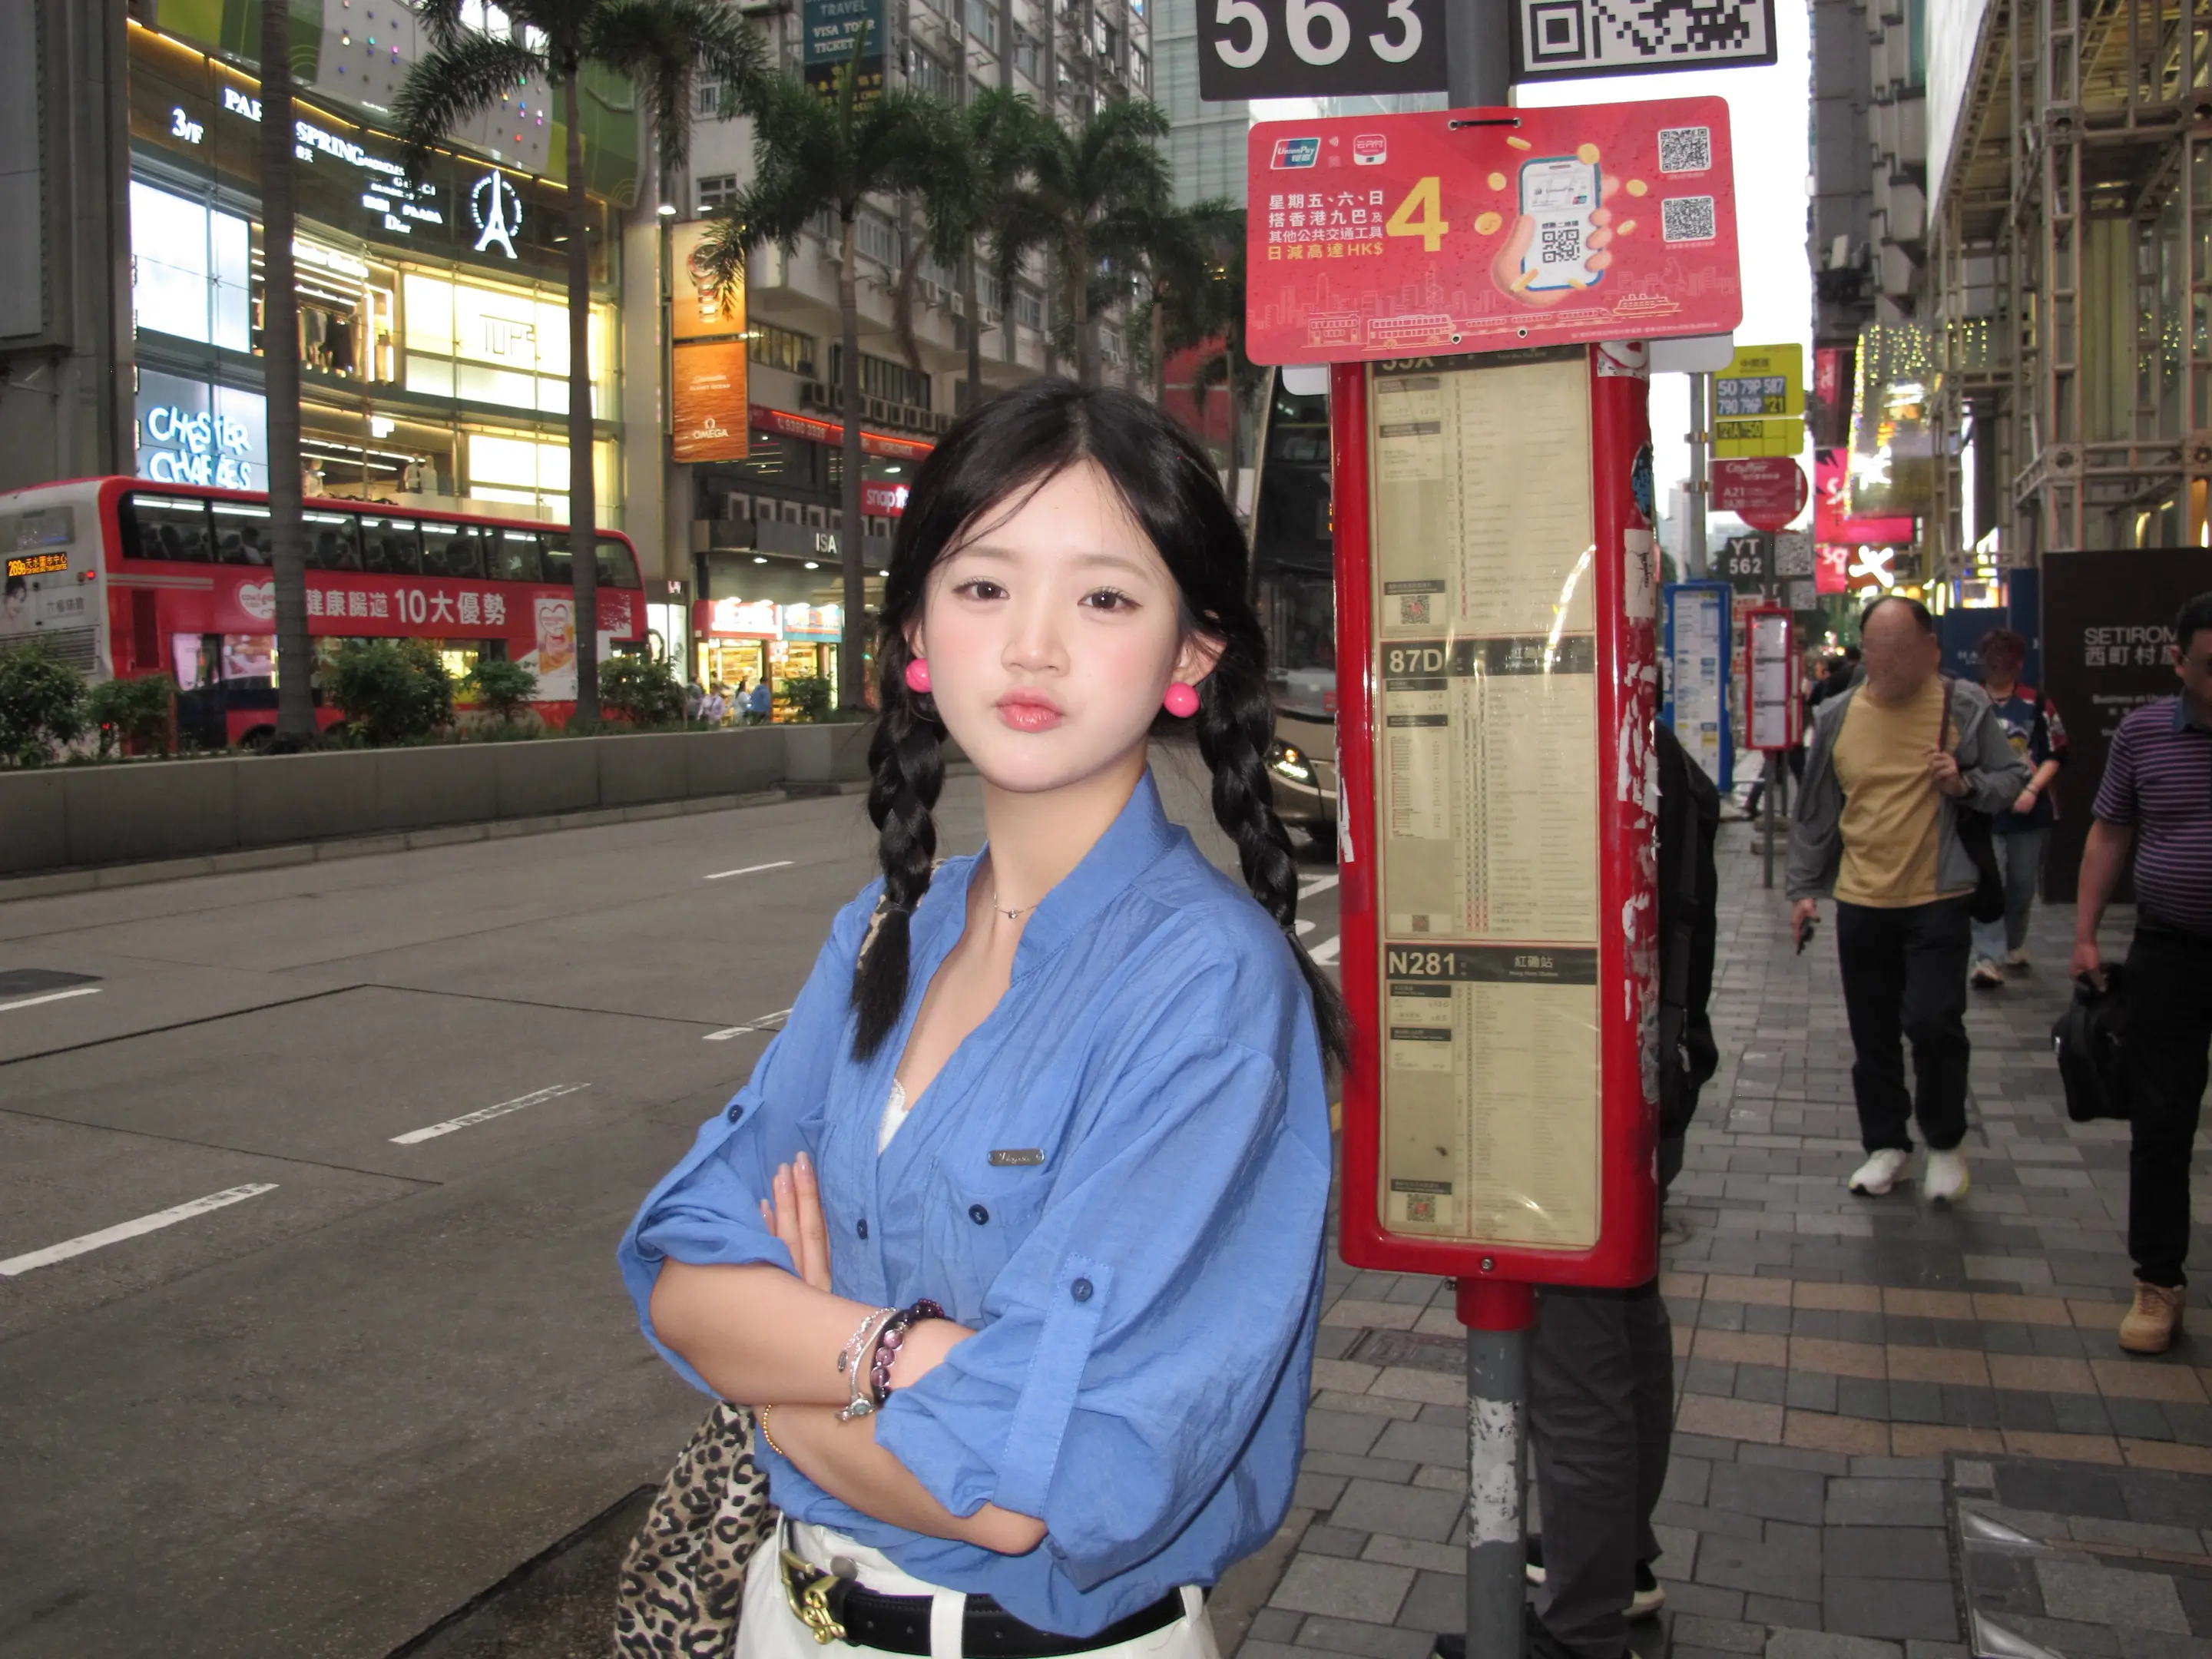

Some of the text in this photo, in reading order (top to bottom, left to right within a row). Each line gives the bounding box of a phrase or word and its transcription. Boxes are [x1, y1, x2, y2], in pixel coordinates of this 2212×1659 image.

[820, 0, 867, 15] TRAVEL
[813, 25, 839, 38] VISA
[1214, 0, 1423, 69] 563
[171, 108, 205, 145] 3/F
[224, 88, 365, 167] PAR SPRING
[1277, 146, 1315, 155] UnionPay
[1386, 176, 1449, 252] 4
[1269, 227, 1383, 243] 其他公共交通工具
[1717, 380, 1737, 396] 50
[694, 429, 729, 439] OMEGA
[816, 533, 837, 553] ISA
[1730, 538, 1760, 556] YT
[8, 559, 26, 577] 269B
[1729, 558, 1763, 575] 562
[1389, 648, 1443, 674] 87D
[1388, 951, 1456, 976] N281
